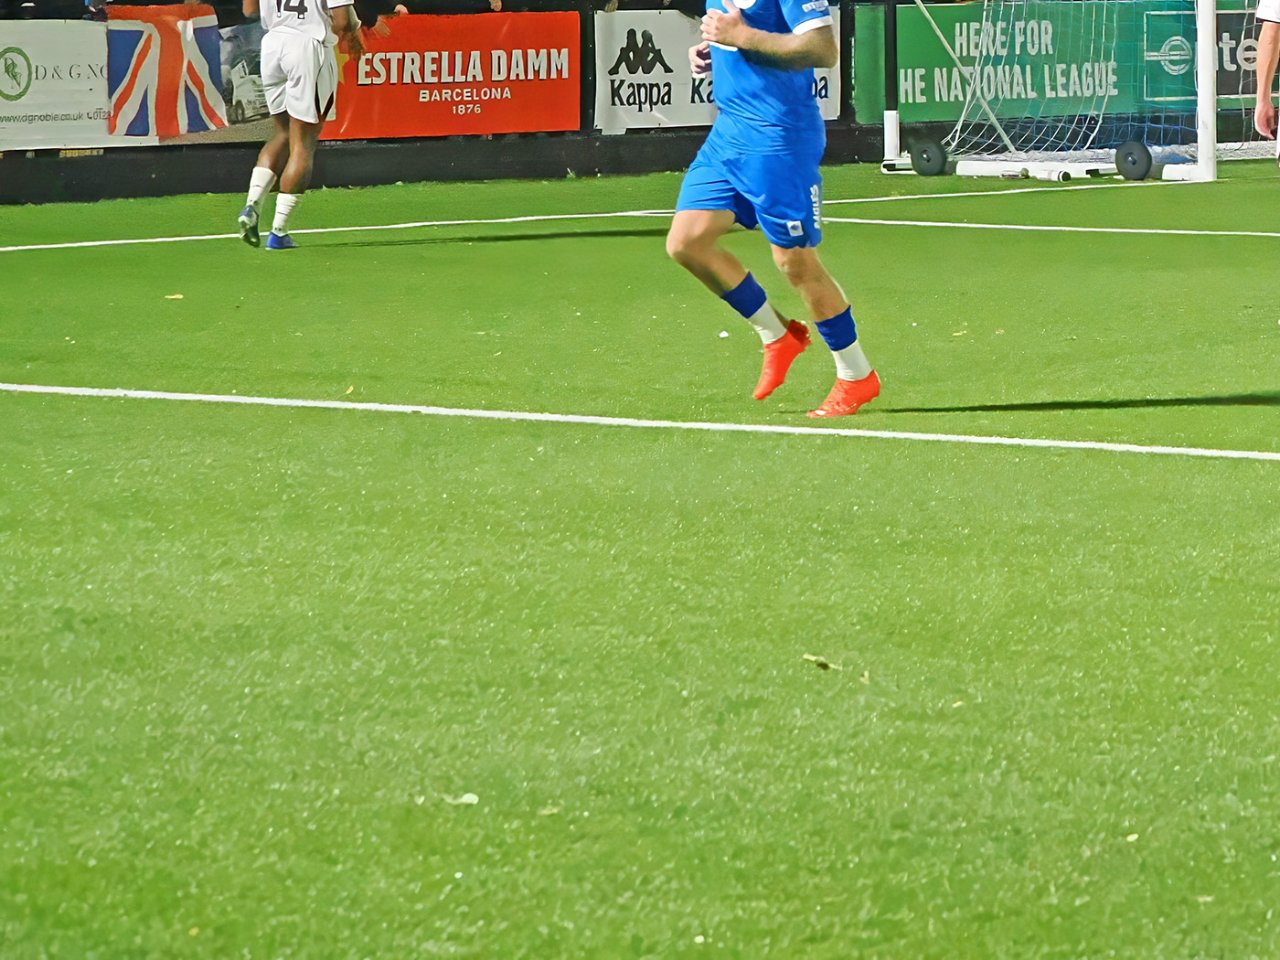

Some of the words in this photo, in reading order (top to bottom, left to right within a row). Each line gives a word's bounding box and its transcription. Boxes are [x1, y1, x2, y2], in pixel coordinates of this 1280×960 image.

[955, 21, 1008, 57] HERE
[1014, 20, 1053, 55] FOR
[35, 65, 47, 80] D
[69, 64, 81, 80] G
[357, 50, 484, 85] ESTRELLA
[491, 48, 569, 81] DAMM
[900, 68, 927, 103] HE
[1044, 61, 1118, 98] LEAGUE
[419, 87, 511, 102] BARCELONA
[453, 104, 481, 115] 1876
[610, 79, 672, 112] Kappa
